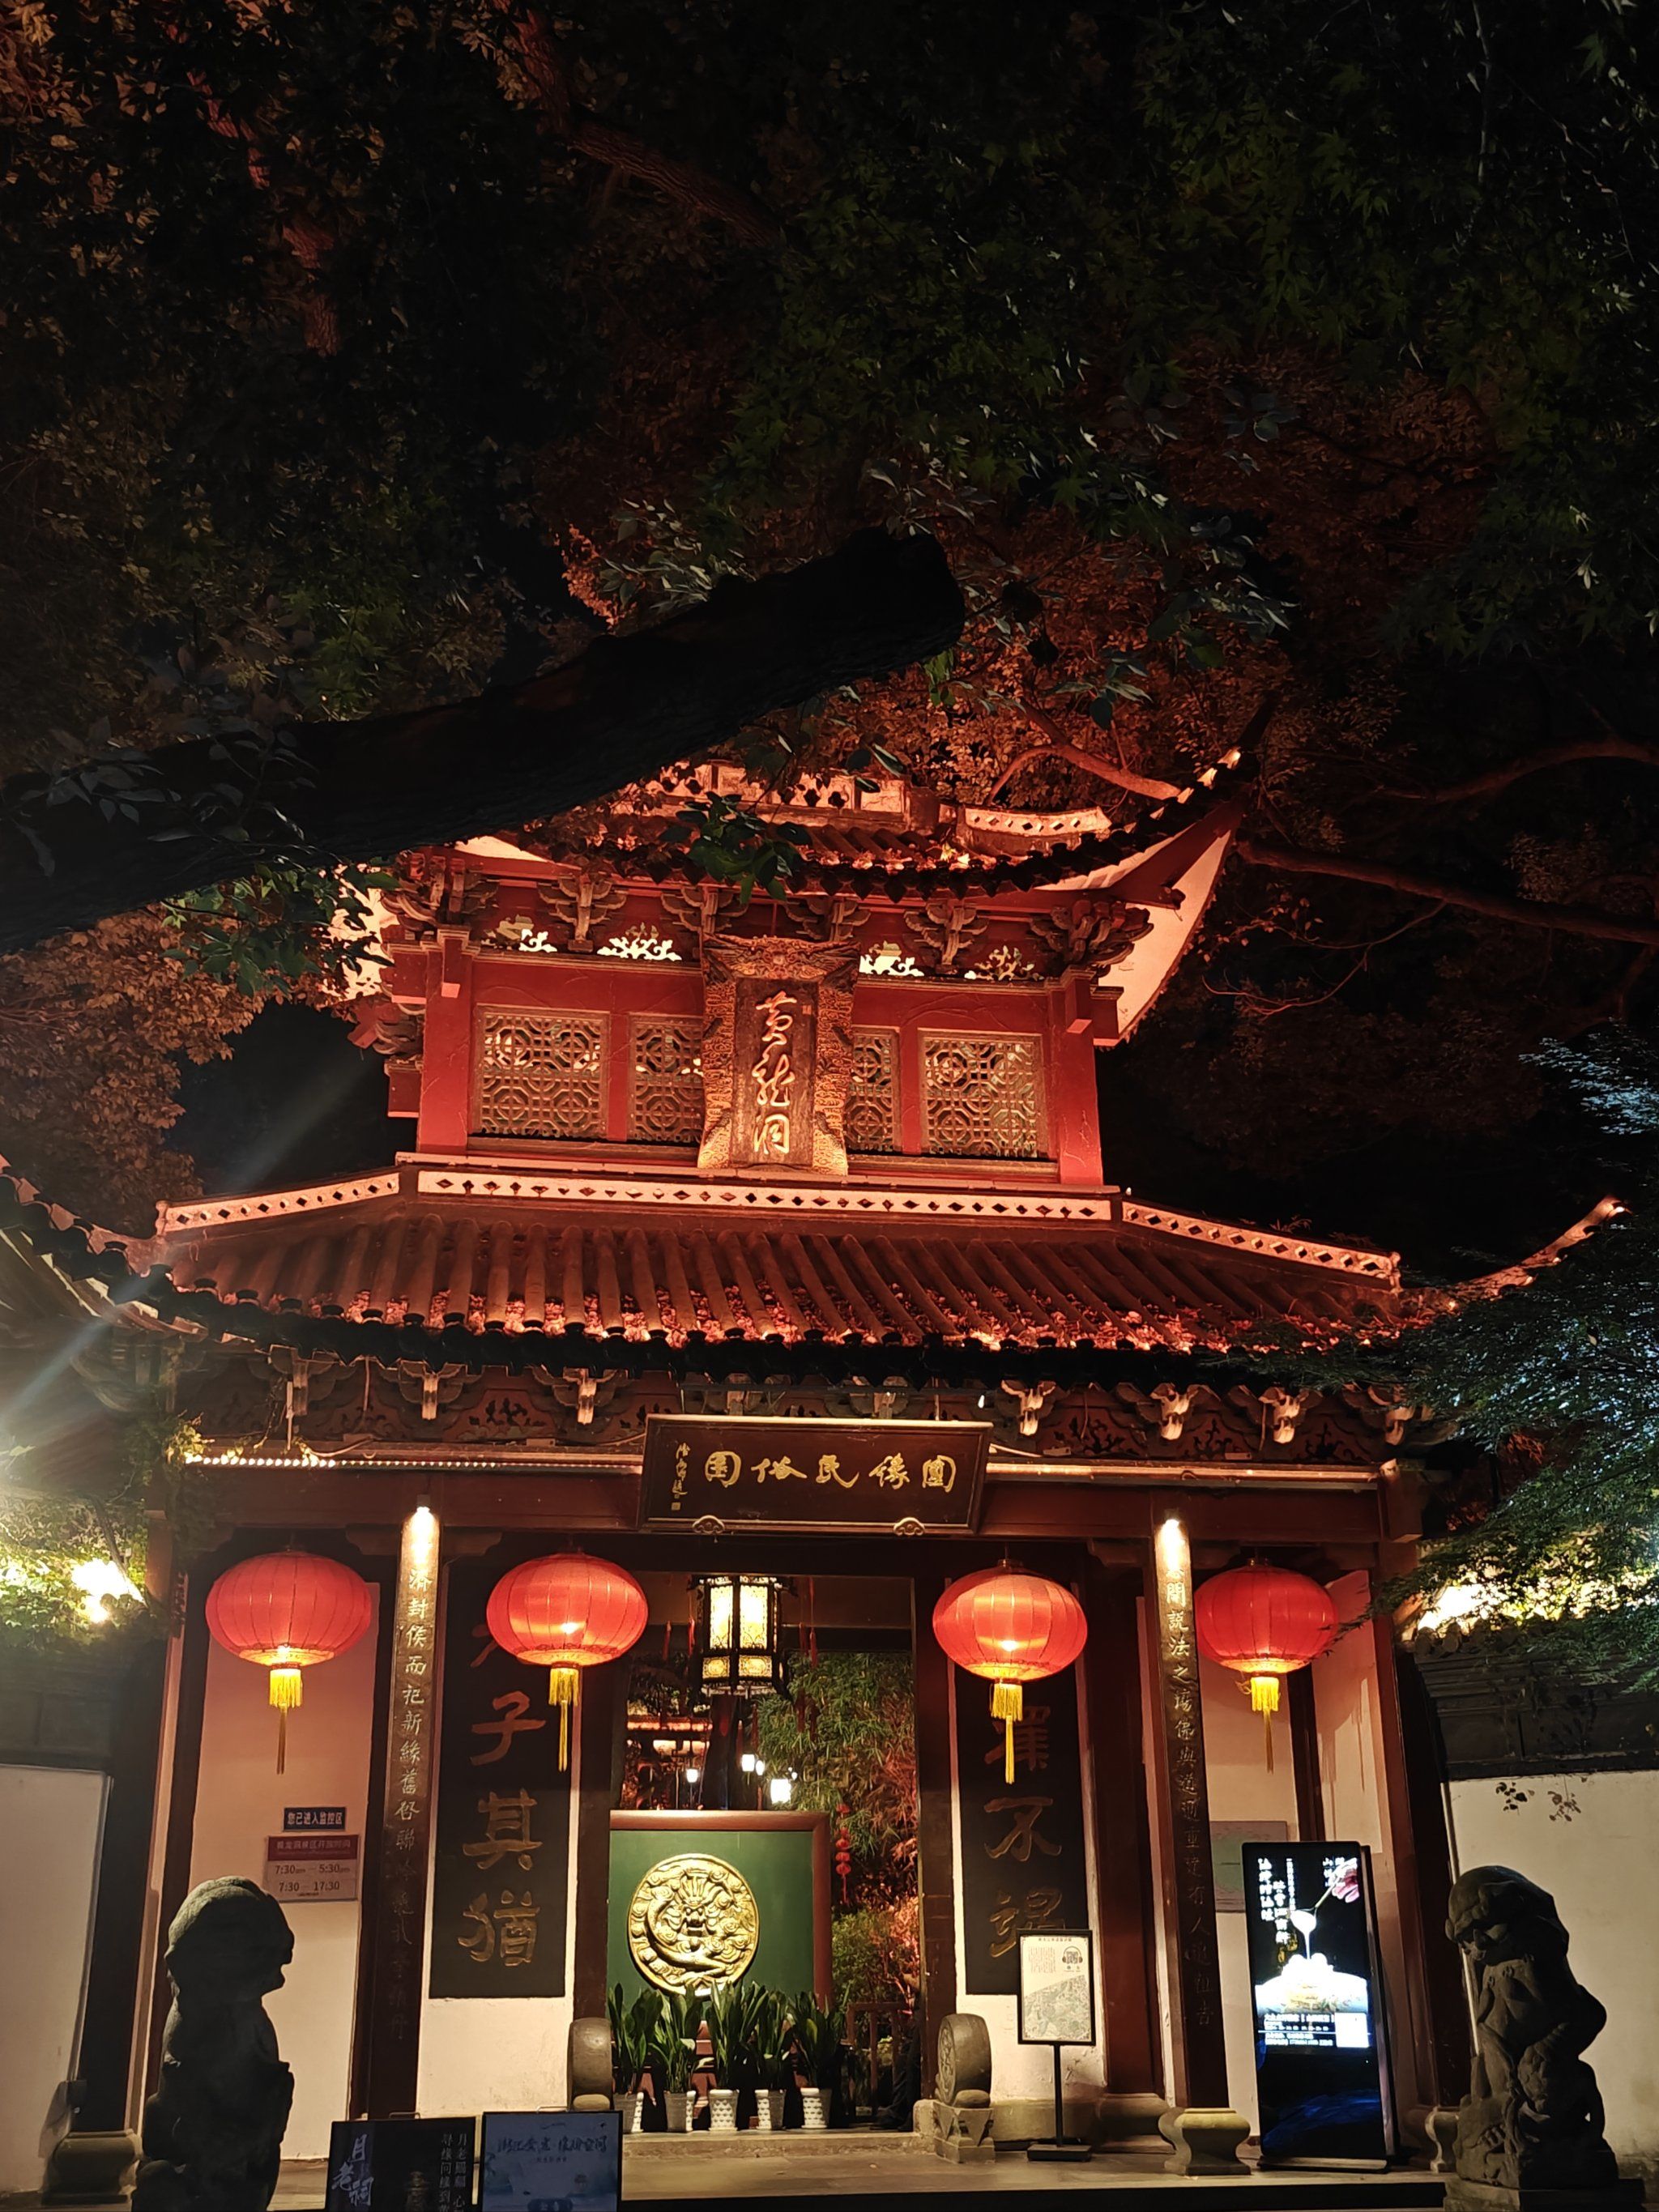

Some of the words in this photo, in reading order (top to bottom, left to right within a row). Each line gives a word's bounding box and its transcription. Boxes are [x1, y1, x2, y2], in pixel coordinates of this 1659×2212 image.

[287, 1811, 343, 1826] 您已进入监控区
[279, 1882, 300, 1892] 7:30
[313, 1881, 340, 1891] 17:30
